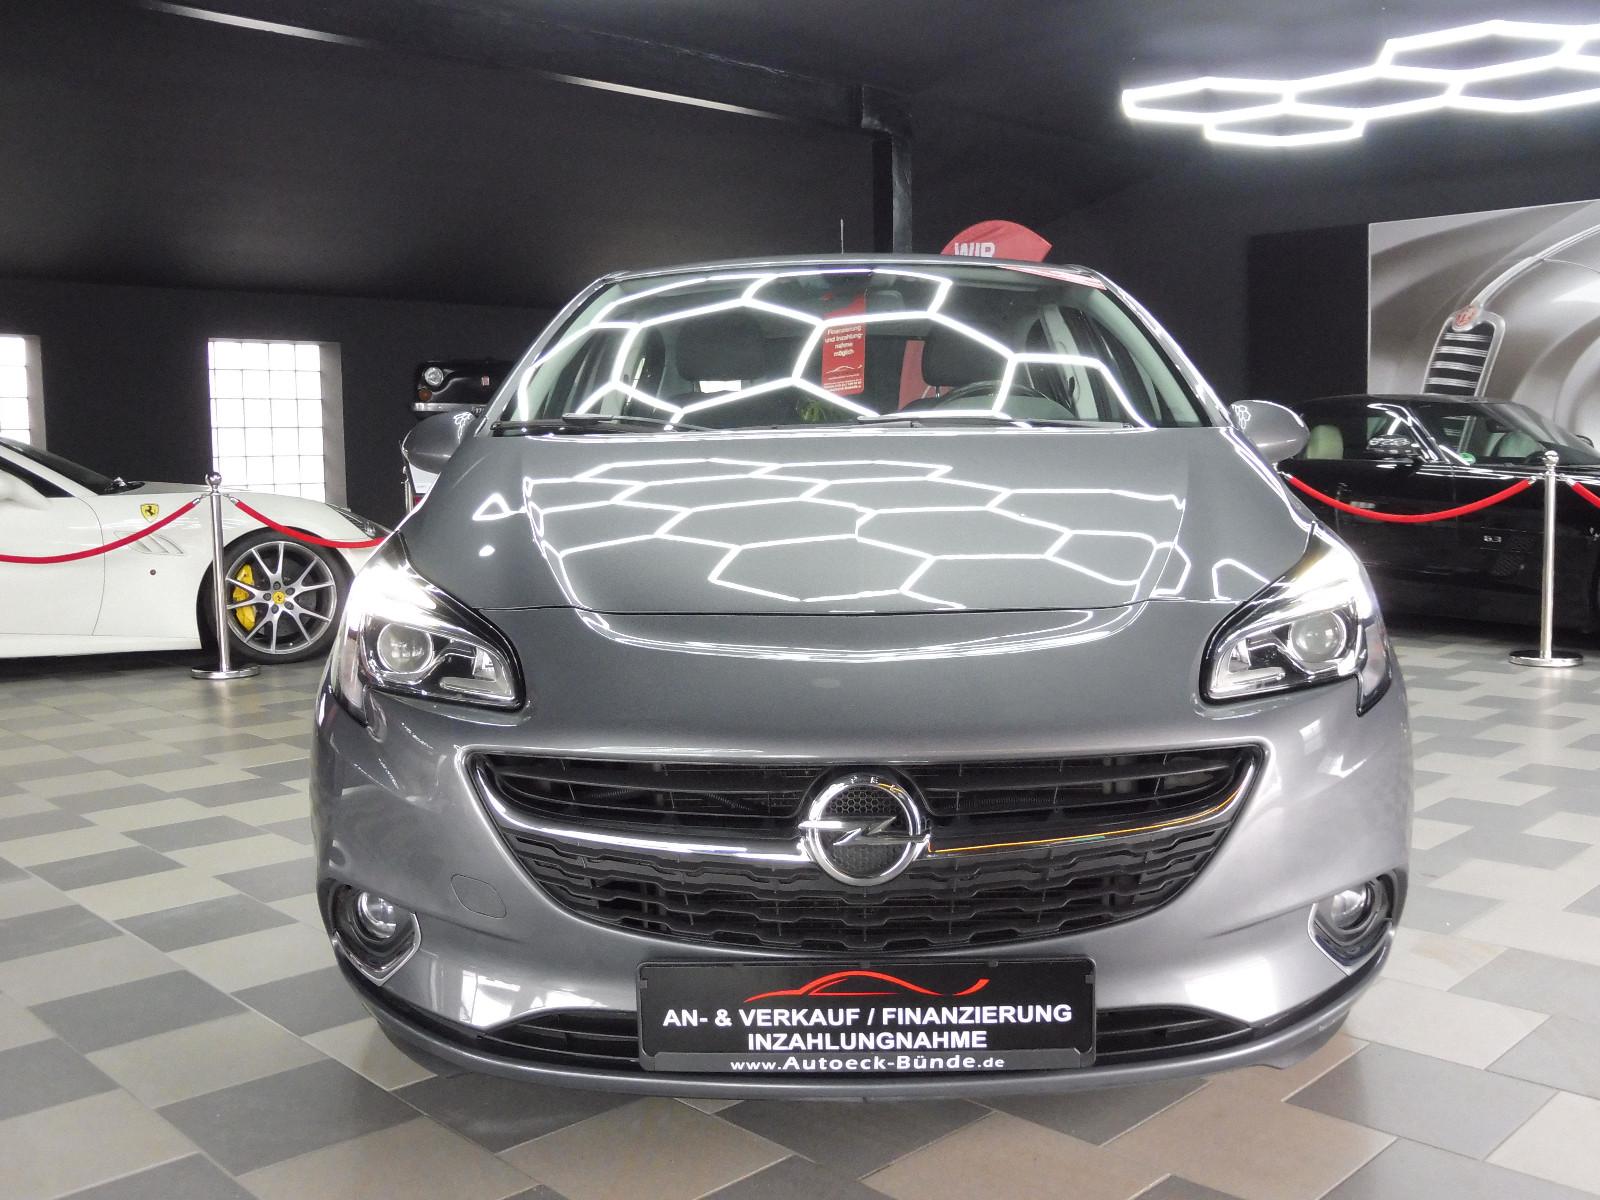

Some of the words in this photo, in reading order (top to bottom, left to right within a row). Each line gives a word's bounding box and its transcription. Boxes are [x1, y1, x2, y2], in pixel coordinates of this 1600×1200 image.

[833, 349, 854, 357] möglich
[662, 1008, 708, 1027] AN-
[714, 1008, 733, 1027] &
[738, 1008, 861, 1027] VERKAUF
[866, 1007, 876, 1026] /
[882, 1004, 1072, 1026] FINANZIERUNG
[748, 1030, 988, 1051] INZAHLUNGNAHME
[730, 1054, 1005, 1071] www.Autoeck-Bünde.de
